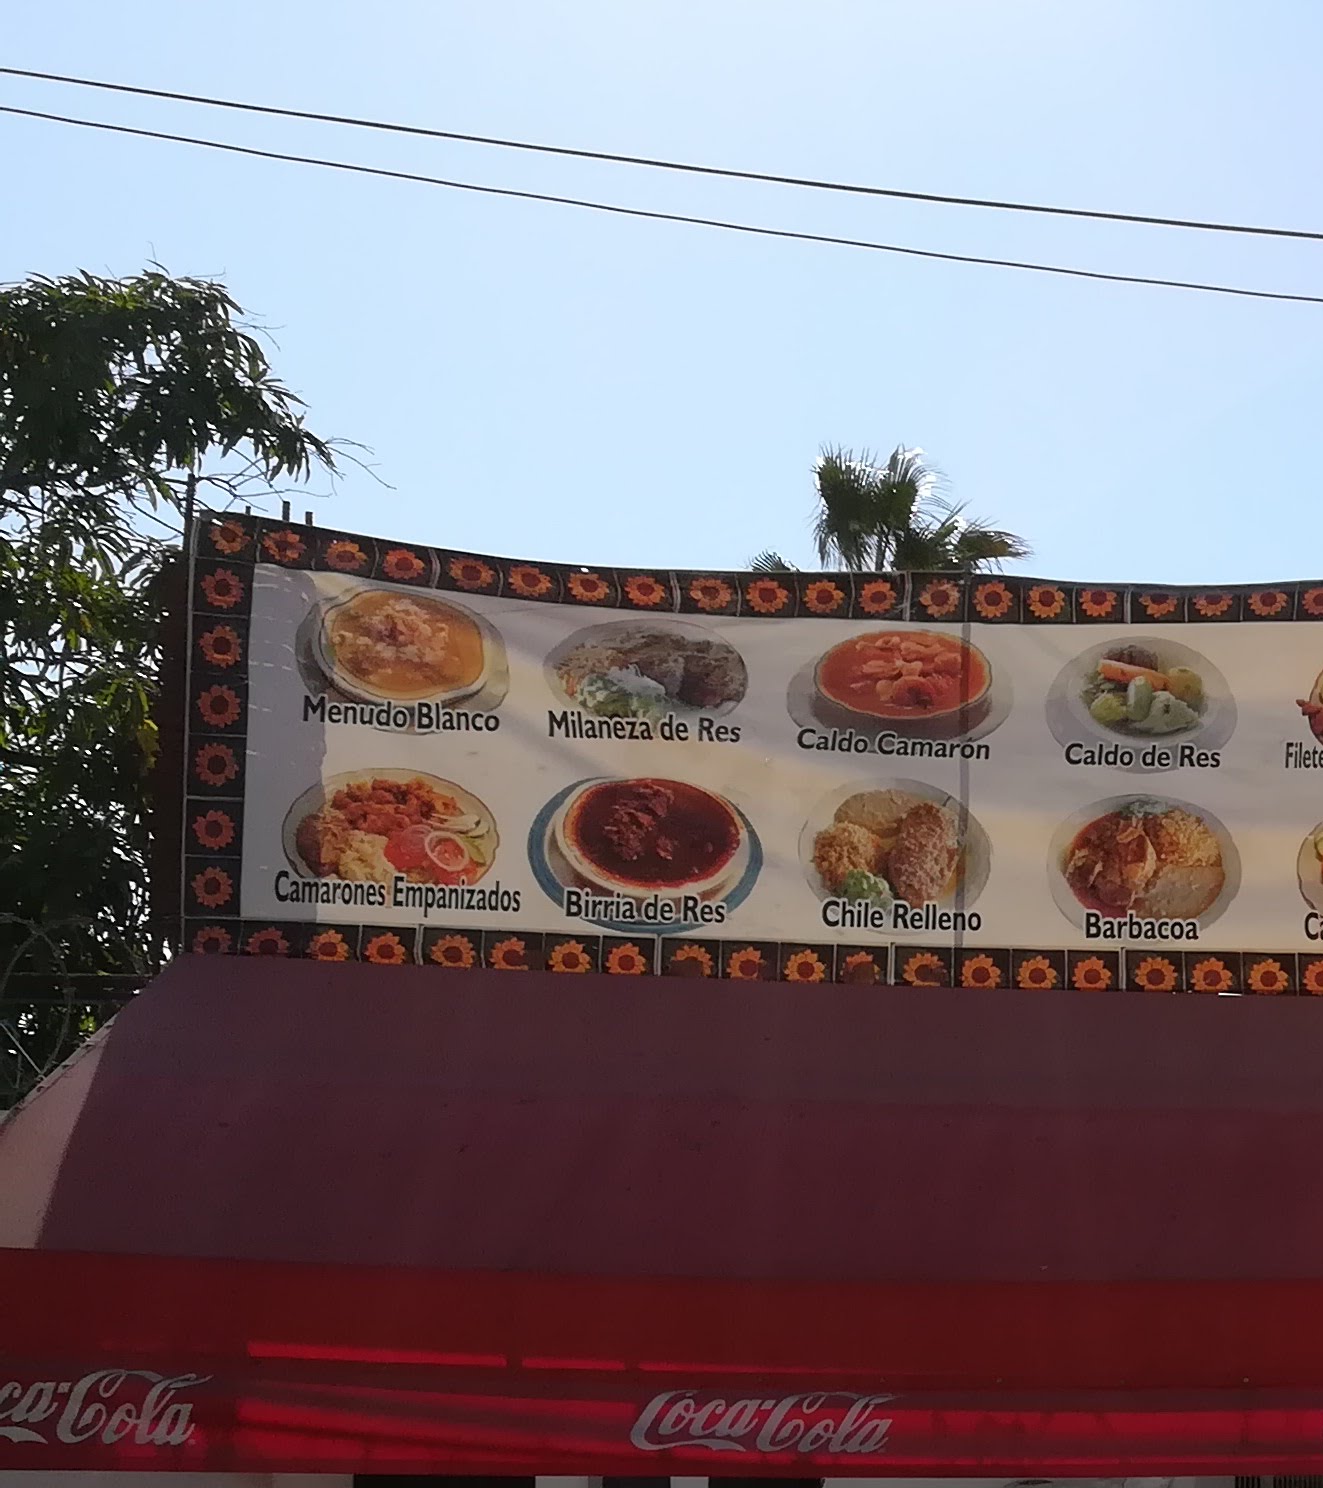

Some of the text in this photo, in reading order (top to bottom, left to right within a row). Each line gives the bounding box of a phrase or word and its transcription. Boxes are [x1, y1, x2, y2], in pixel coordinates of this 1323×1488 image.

[302, 694, 501, 733] Menudo Blanco
[547, 710, 742, 744] Milaneza de Res
[796, 727, 991, 762] Caldo Camarón
[1064, 742, 1222, 770] Caldo de Res
[273, 869, 522, 918] Camarones Empanizados
[564, 889, 727, 924] Birria de Res
[821, 900, 983, 932] Chile Relleno
[1085, 911, 1200, 940] Barbacoa
[629, 1389, 900, 1453] Coca-Cola
